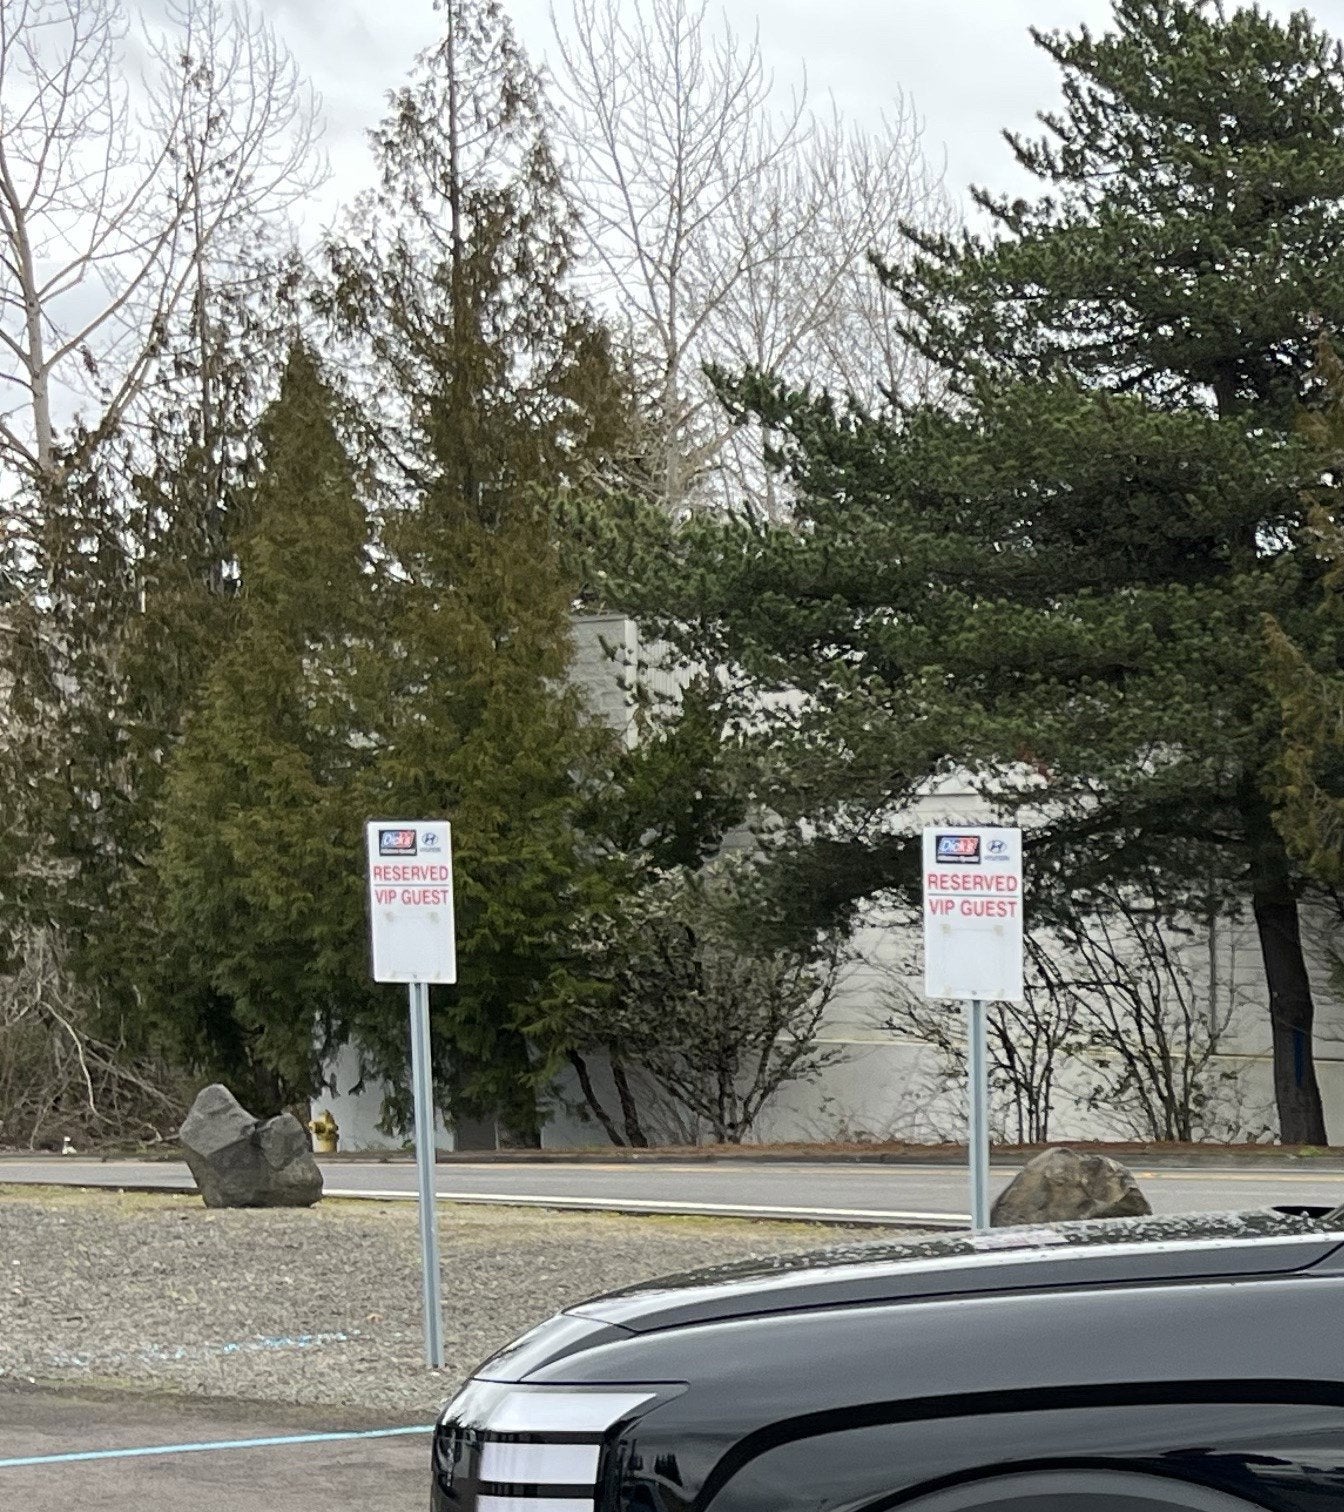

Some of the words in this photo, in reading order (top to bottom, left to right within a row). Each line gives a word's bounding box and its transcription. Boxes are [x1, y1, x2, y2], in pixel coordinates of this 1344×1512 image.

[373, 865, 449, 882] RESERVED
[927, 873, 1018, 892] RESERVED
[375, 890, 397, 905] VIP
[401, 890, 449, 906] GUEST
[929, 899, 955, 916] VIP
[960, 900, 1018, 918] GUEST
